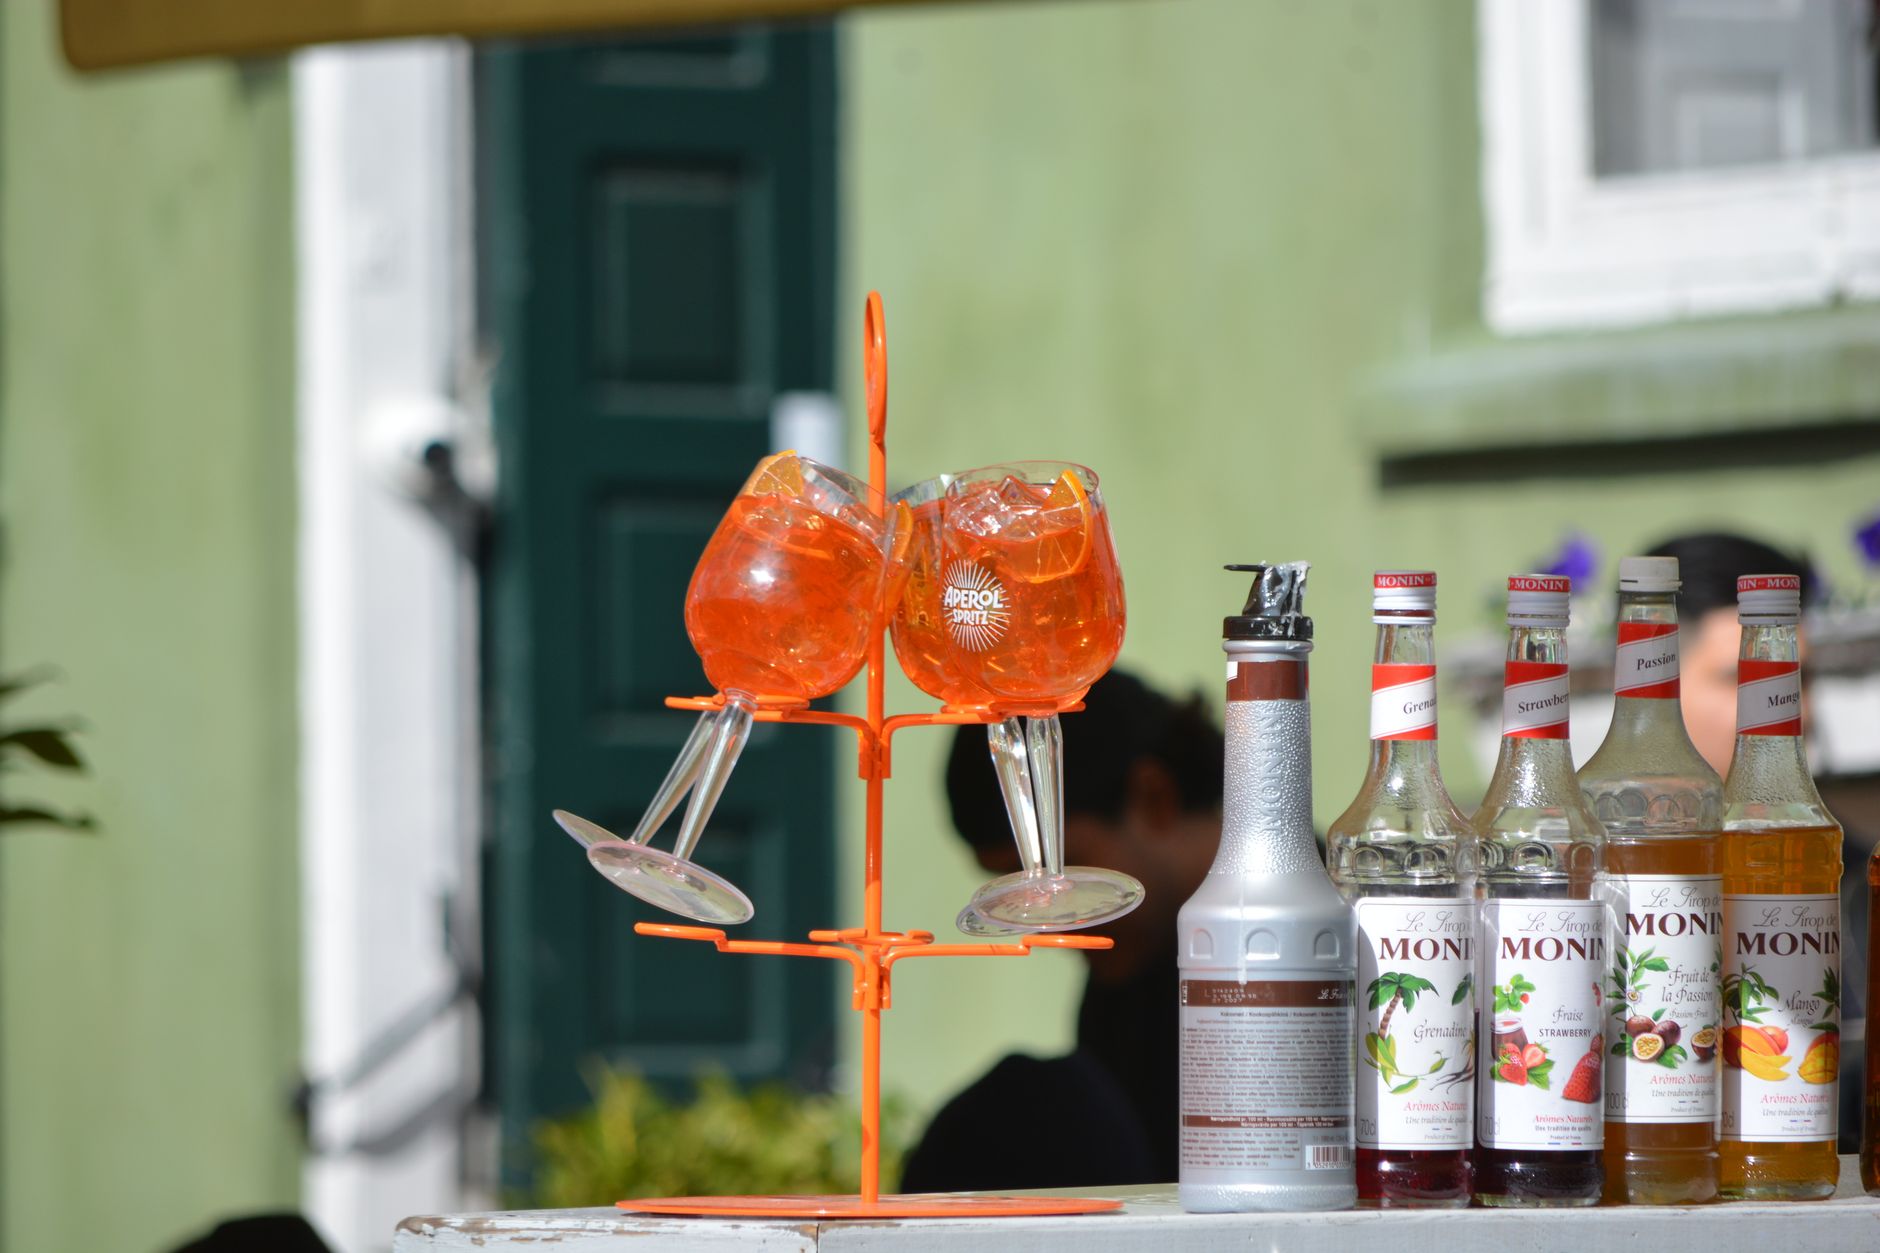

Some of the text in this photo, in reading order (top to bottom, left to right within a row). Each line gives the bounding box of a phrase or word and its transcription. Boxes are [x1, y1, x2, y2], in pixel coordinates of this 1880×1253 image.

[1377, 575, 1424, 587] MONIN
[1515, 579, 1564, 590] MONIN
[944, 586, 1003, 610] APEROL
[953, 608, 988, 625] SPRITZ
[1636, 652, 1676, 671] Passion
[1259, 709, 1282, 835] MONIN
[1642, 887, 1671, 908] Le
[1673, 886, 1712, 912] Sirop
[1396, 911, 1426, 932] Le
[1428, 911, 1467, 938] Sirop
[1518, 911, 1547, 932] Le
[1550, 911, 1590, 938] Sirop
[1625, 912, 1724, 936] MONIN
[1752, 906, 1782, 928] Le
[1785, 906, 1825, 932] Sirop
[1378, 937, 1474, 961] MONI
[1737, 931, 1839, 956] MONIN
[1668, 964, 1710, 986] Fruit de
[1661, 984, 1713, 1005] la Passion
[1778, 990, 1820, 1015] Mango
[1552, 1004, 1583, 1024] Fraise
[1413, 1019, 1467, 1043] Grenadine
[1539, 1028, 1592, 1038] STRAWBERRY
[1650, 1072, 1686, 1085] Arômes
[1403, 1099, 1440, 1111] Arômes
[1760, 1092, 1798, 1104] Arômes
